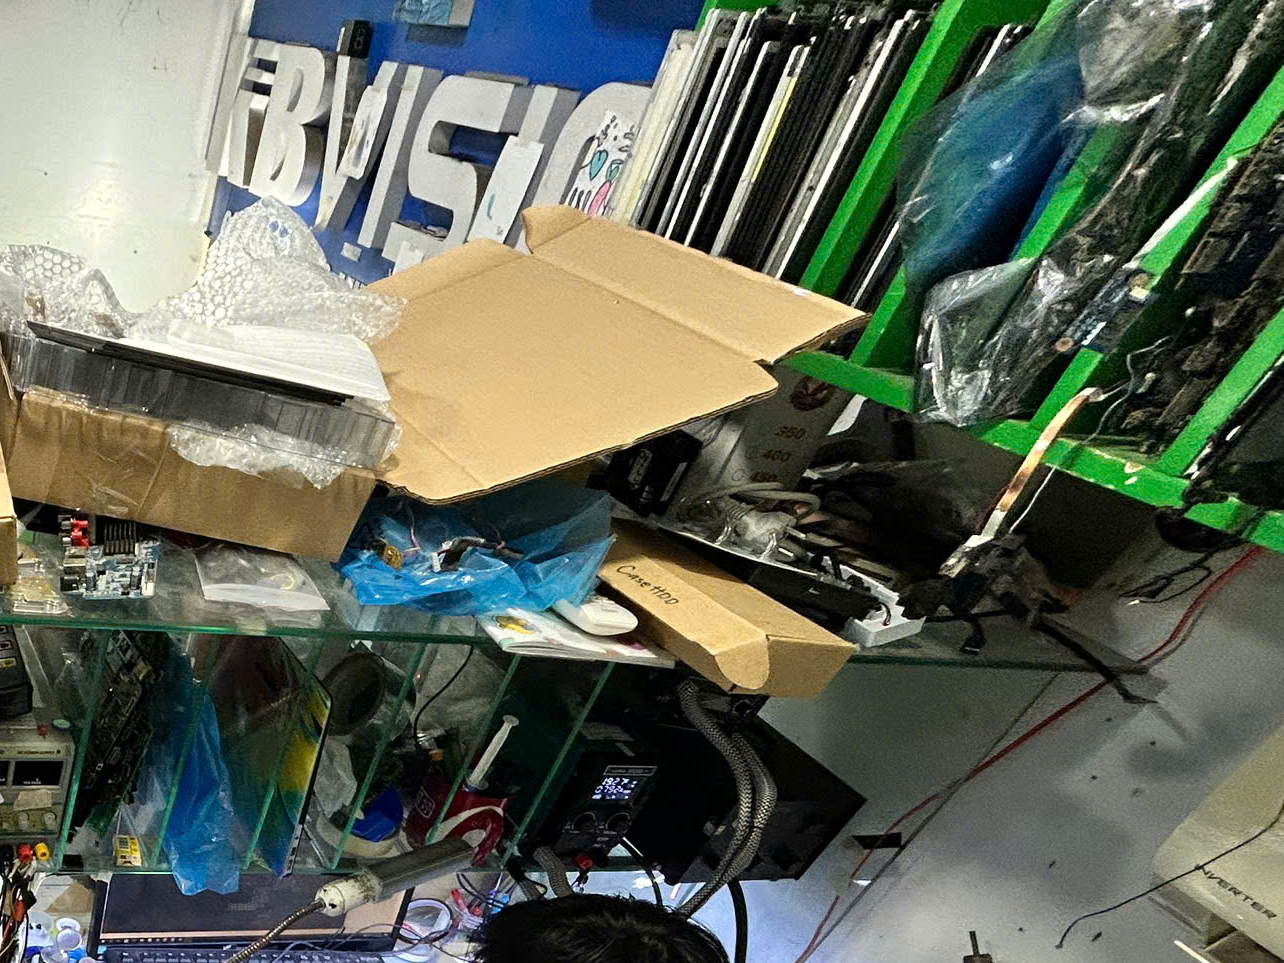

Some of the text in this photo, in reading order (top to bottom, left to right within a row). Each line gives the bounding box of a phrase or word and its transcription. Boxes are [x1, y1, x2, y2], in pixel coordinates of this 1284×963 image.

[616, 564, 679, 605] Case HDD
[1195, 864, 1277, 920] INVERTER
